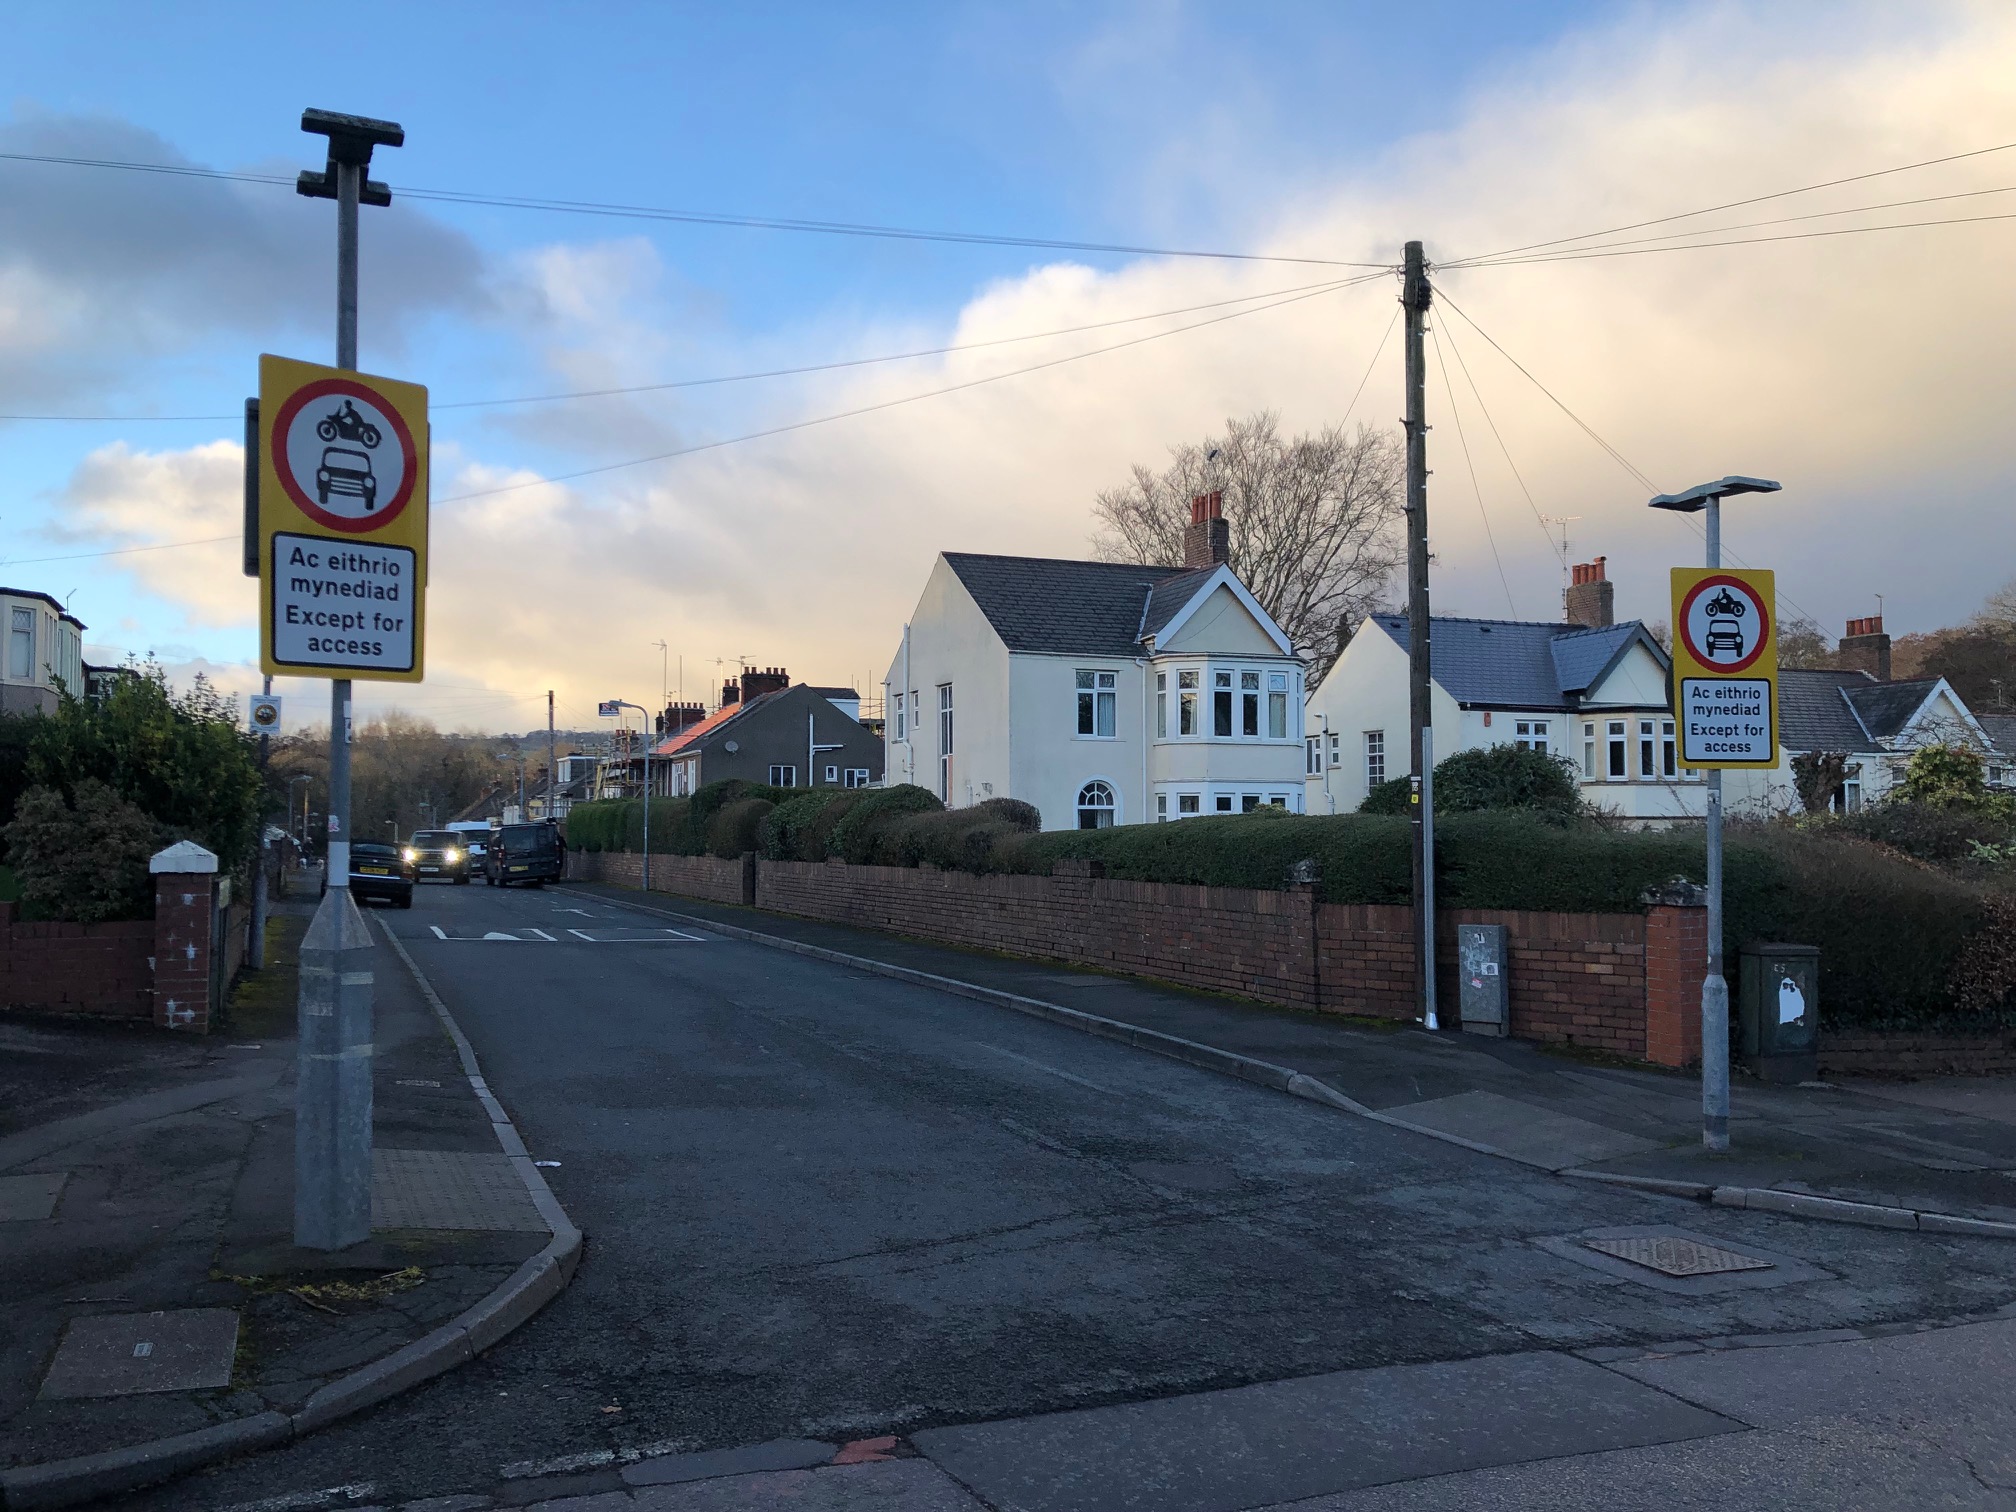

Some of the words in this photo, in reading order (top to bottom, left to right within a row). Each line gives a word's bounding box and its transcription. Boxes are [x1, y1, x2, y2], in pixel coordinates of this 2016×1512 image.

[290, 547, 319, 568] Ac
[329, 553, 400, 576] eithrio
[291, 577, 399, 601] mynediad
[286, 605, 364, 631] Except
[373, 612, 403, 632] for
[308, 637, 383, 656] access
[1692, 686, 1710, 699] Ac
[1715, 686, 1760, 699] eithrio
[1693, 703, 1760, 717] mynediad
[1691, 723, 1739, 737] Except
[1744, 723, 1764, 736] for
[1705, 742, 1751, 752] access
